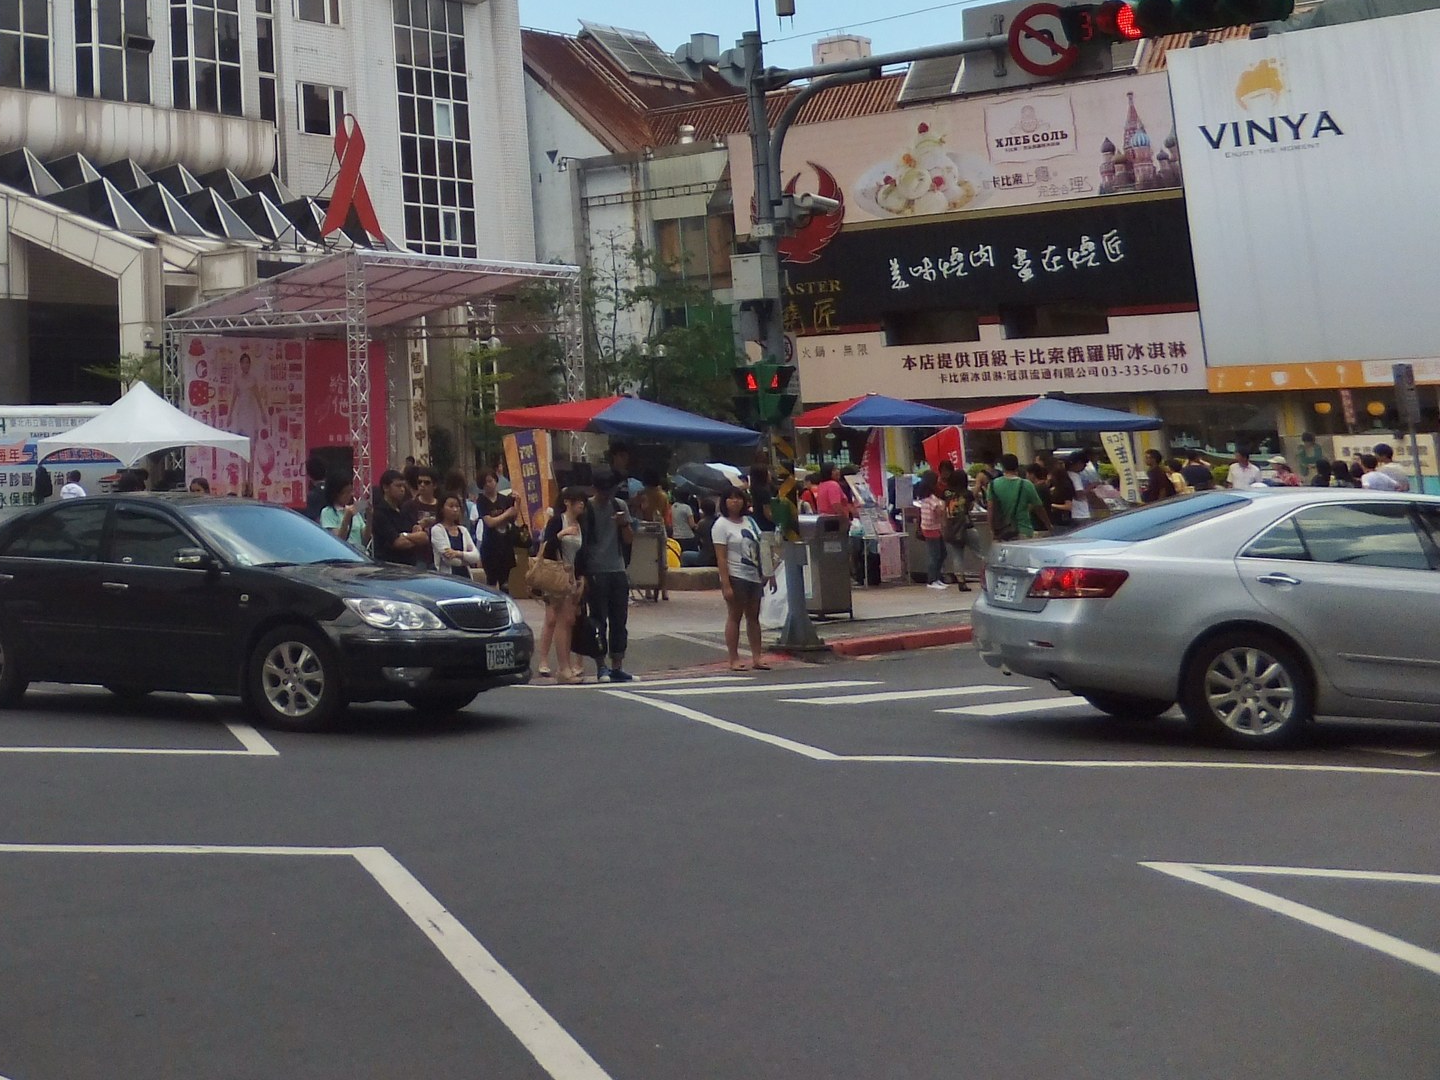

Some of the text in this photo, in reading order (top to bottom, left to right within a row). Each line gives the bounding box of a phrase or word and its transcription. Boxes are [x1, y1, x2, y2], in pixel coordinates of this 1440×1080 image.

[1198, 110, 1344, 149] VINYA
[782, 279, 841, 296] ASTER
[902, 341, 1188, 371] 本店提供頂級卡比索俄羅斯冰淇淋
